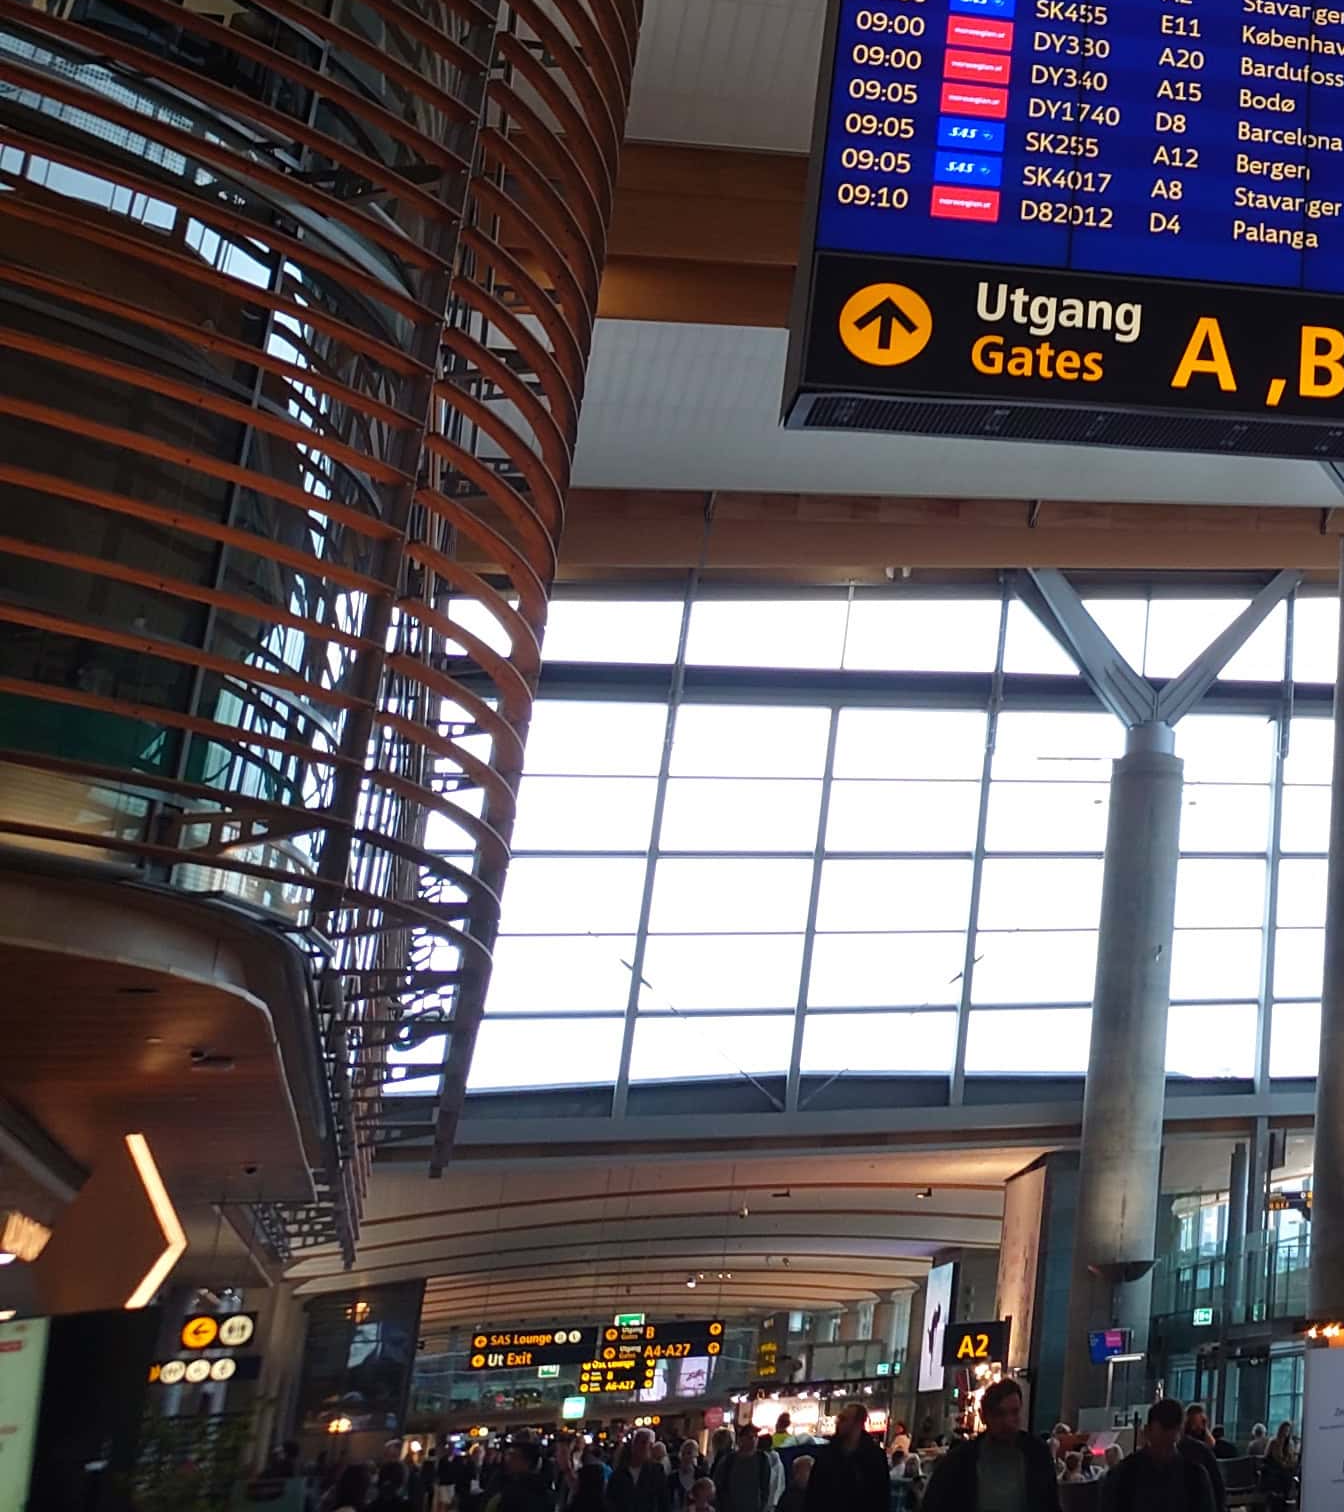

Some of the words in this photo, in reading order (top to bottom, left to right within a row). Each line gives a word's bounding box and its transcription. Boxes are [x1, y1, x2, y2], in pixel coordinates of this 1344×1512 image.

[849, 78, 918, 104] 09:05
[1028, 97, 1121, 126] DY1740
[1155, 111, 1187, 134] D8
[1237, 120, 1343, 152] Barcelona
[837, 183, 909, 209] 09:10
[1020, 199, 1113, 228] D82012
[1149, 212, 1181, 235] D4
[1233, 219, 1319, 250] Palanga
[976, 281, 1142, 343] Utgang
[971, 334, 1104, 382] Gates
[1171, 316, 1238, 393] A
[489, 1334, 511, 1346] SAS
[513, 1333, 552, 1347] Lounge
[646, 1326, 655, 1339] B
[956, 1334, 989, 1359] A2
[487, 1355, 504, 1367] Ut
[507, 1352, 533, 1366] Exit
[643, 1344, 691, 1359] A4-A27
